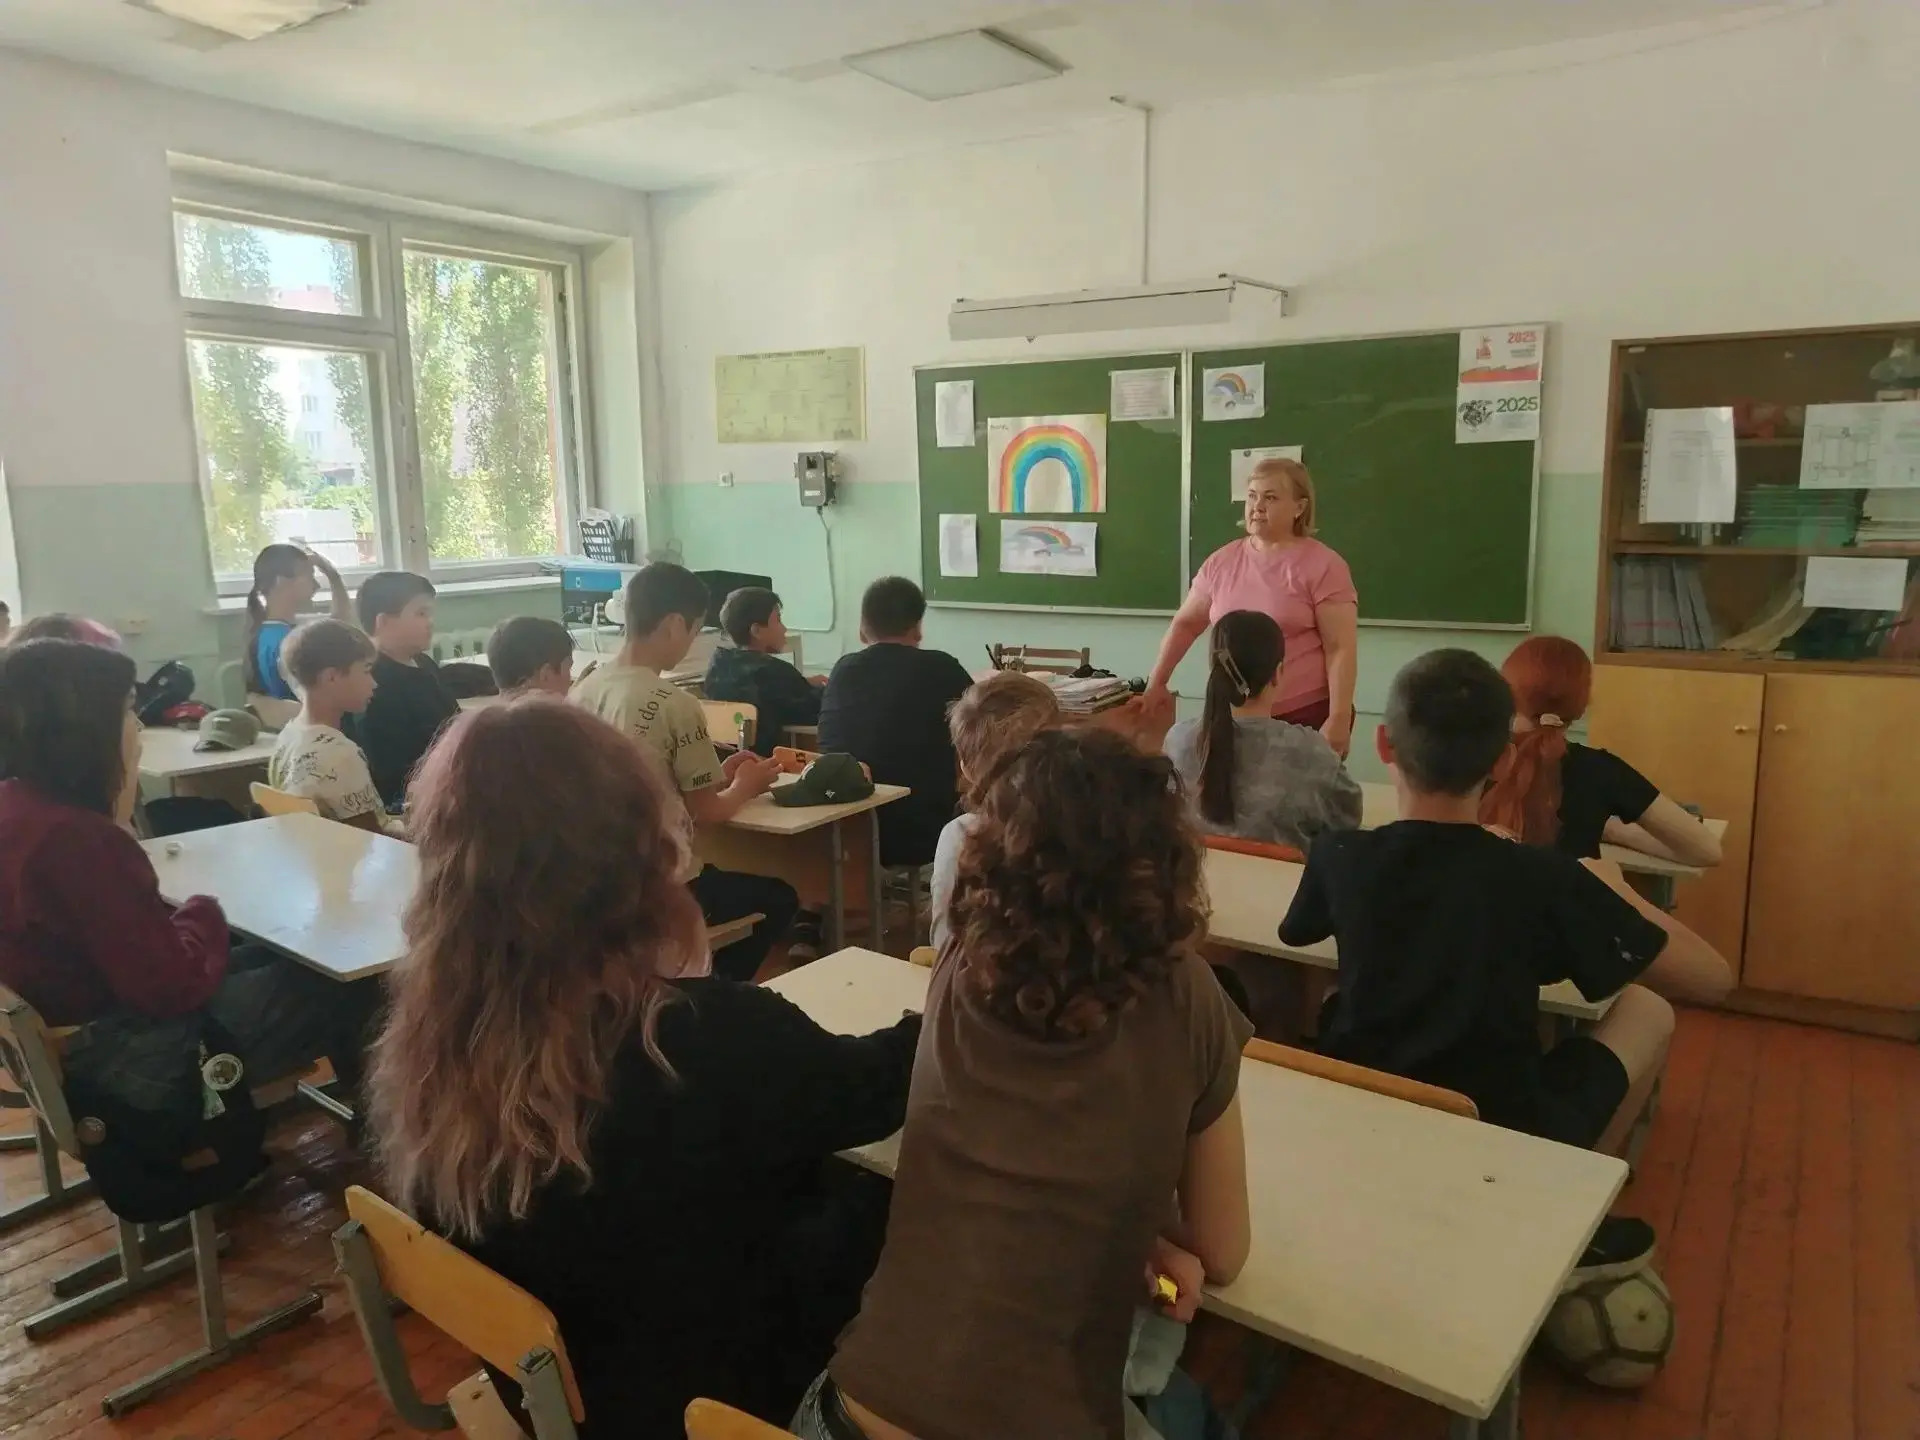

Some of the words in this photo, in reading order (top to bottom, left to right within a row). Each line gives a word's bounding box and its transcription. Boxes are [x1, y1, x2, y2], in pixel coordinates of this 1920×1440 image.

[1496, 397, 1538, 412] 2025
[638, 701, 659, 721] do
[692, 772, 712, 787] NIKE
